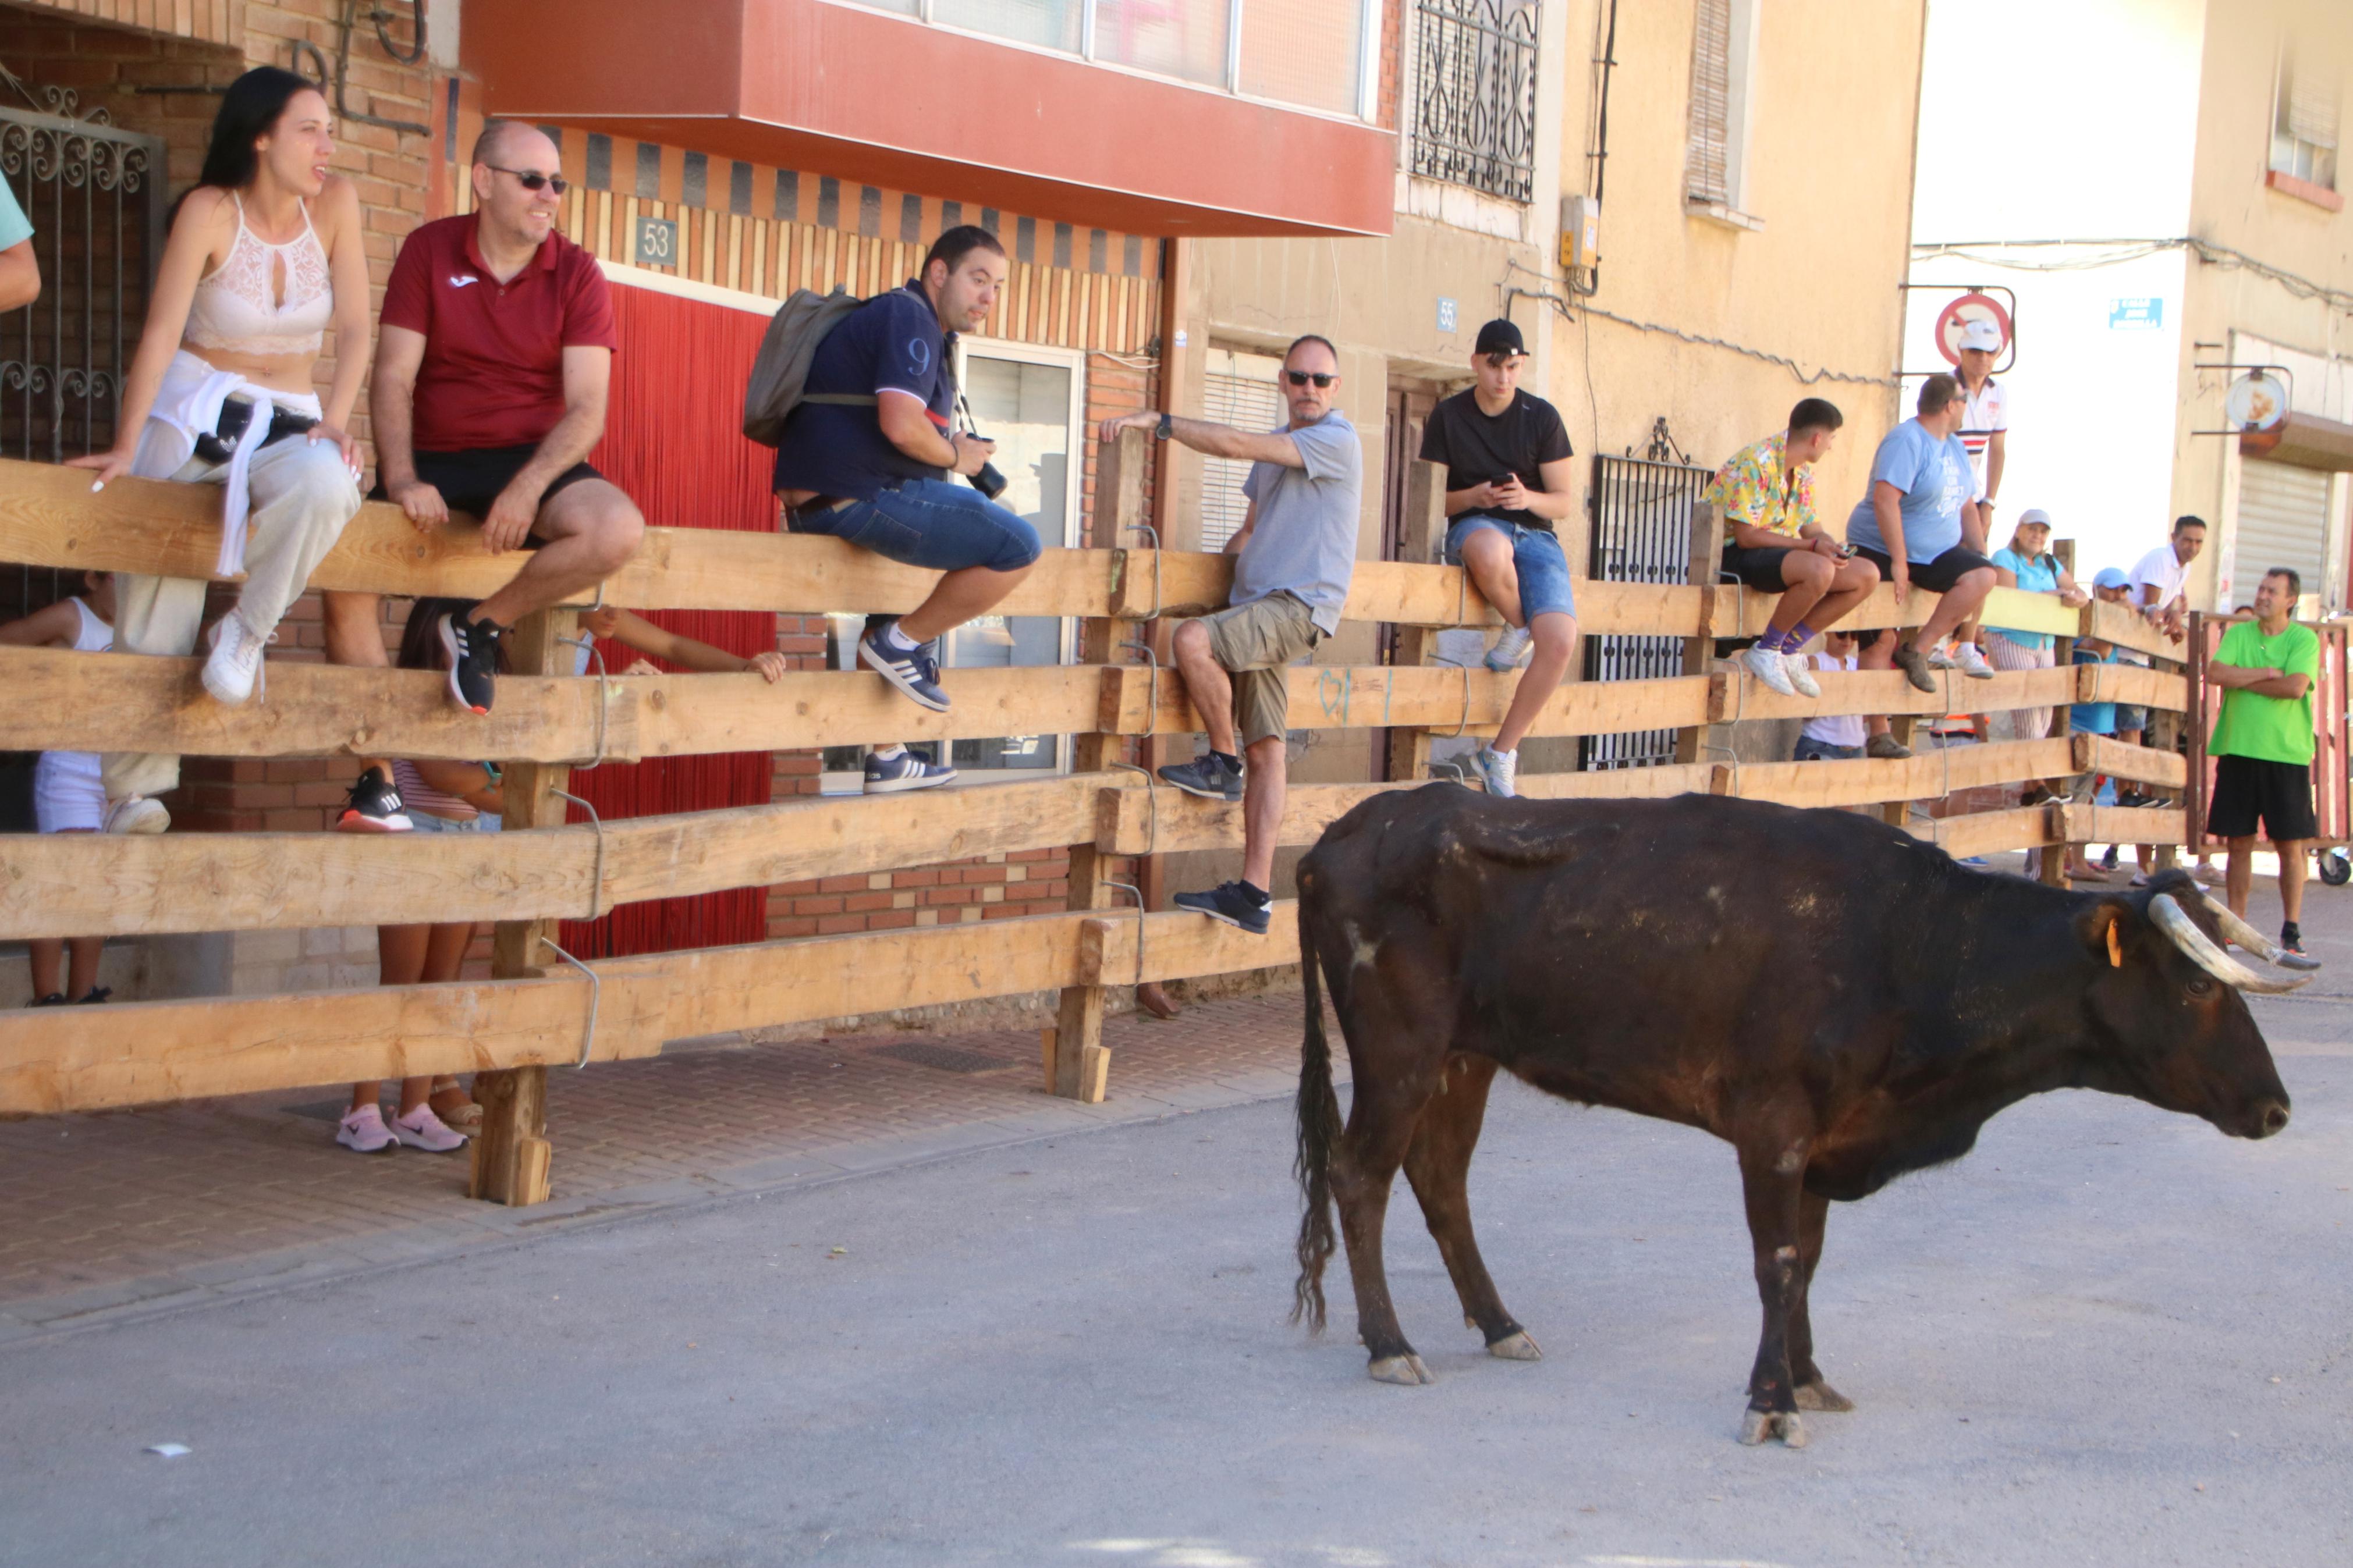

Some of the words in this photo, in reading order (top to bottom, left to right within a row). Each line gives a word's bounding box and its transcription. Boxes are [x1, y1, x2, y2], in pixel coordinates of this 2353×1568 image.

[644, 223, 669, 257] 53
[1441, 301, 1453, 326] 55
[908, 337, 930, 376] 9
